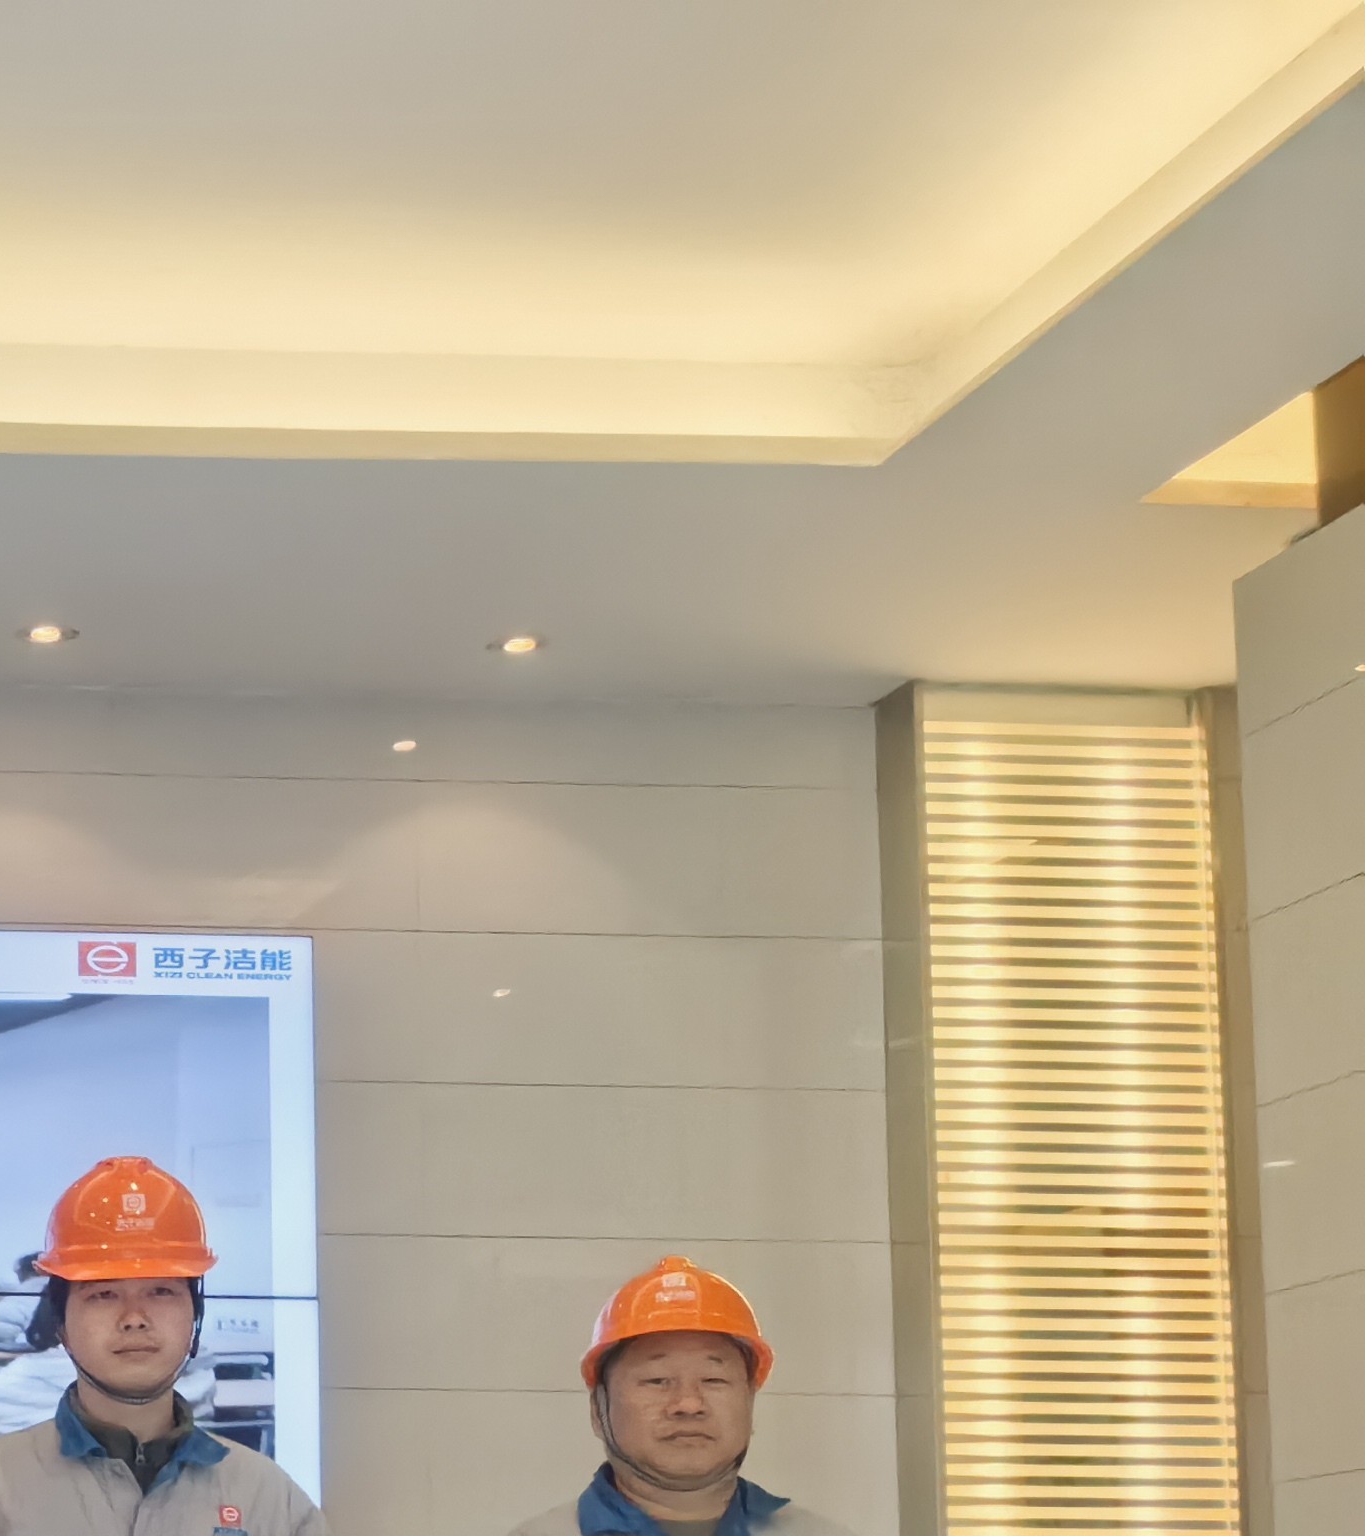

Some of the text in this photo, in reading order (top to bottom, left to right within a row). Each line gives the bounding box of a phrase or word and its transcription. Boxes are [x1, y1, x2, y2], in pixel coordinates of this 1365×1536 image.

[152, 947, 292, 971] 西子洁能
[186, 971, 233, 980] CLEAN
[236, 973, 292, 981] ENERGY
